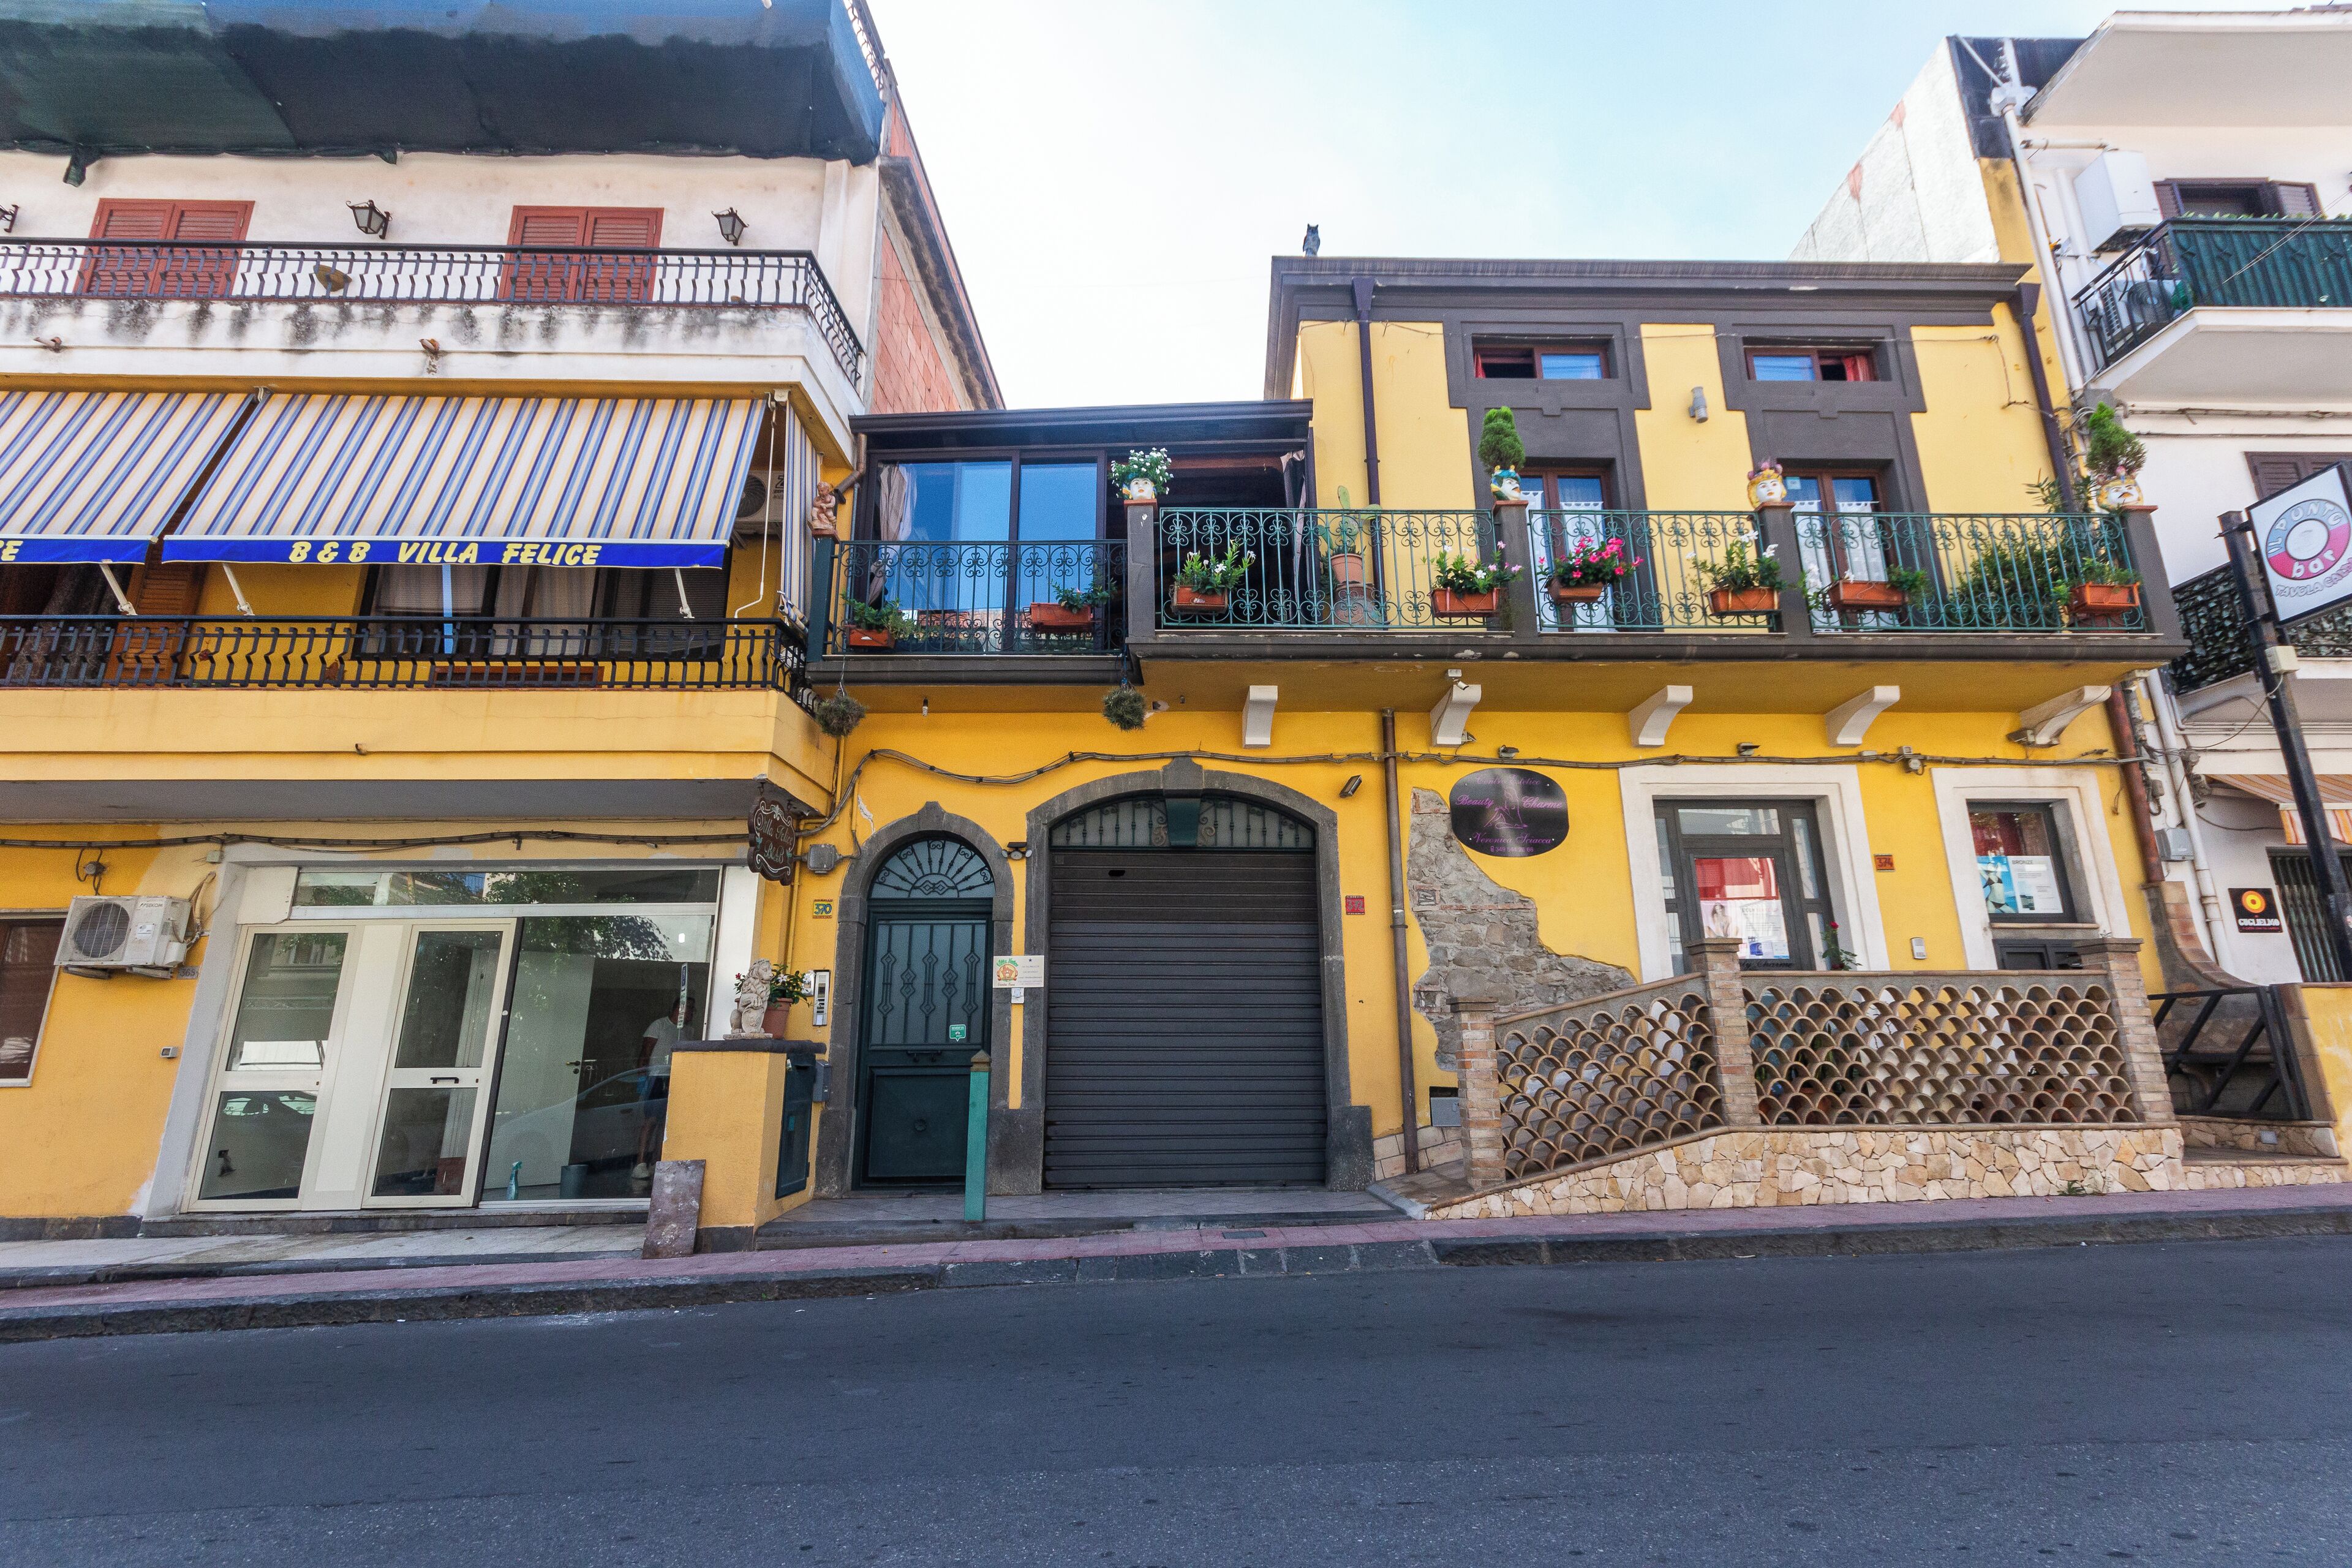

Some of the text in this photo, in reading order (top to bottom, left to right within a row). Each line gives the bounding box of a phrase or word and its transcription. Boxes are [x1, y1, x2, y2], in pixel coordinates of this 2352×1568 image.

[2275, 502, 2343, 531] PUNTO
[0, 540, 24, 561] E
[289, 541, 602, 565] B & B VILLA FELICE
[2291, 549, 2335, 578] bar
[2276, 557, 2352, 597] TAVOLA CALD
[1509, 774, 1541, 785] Etetico
[1456, 794, 1562, 809] Beauty Charme
[775, 824, 793, 845] Felice
[1472, 832, 1552, 844] Veronica Sciacca
[814, 903, 832, 914] 370
